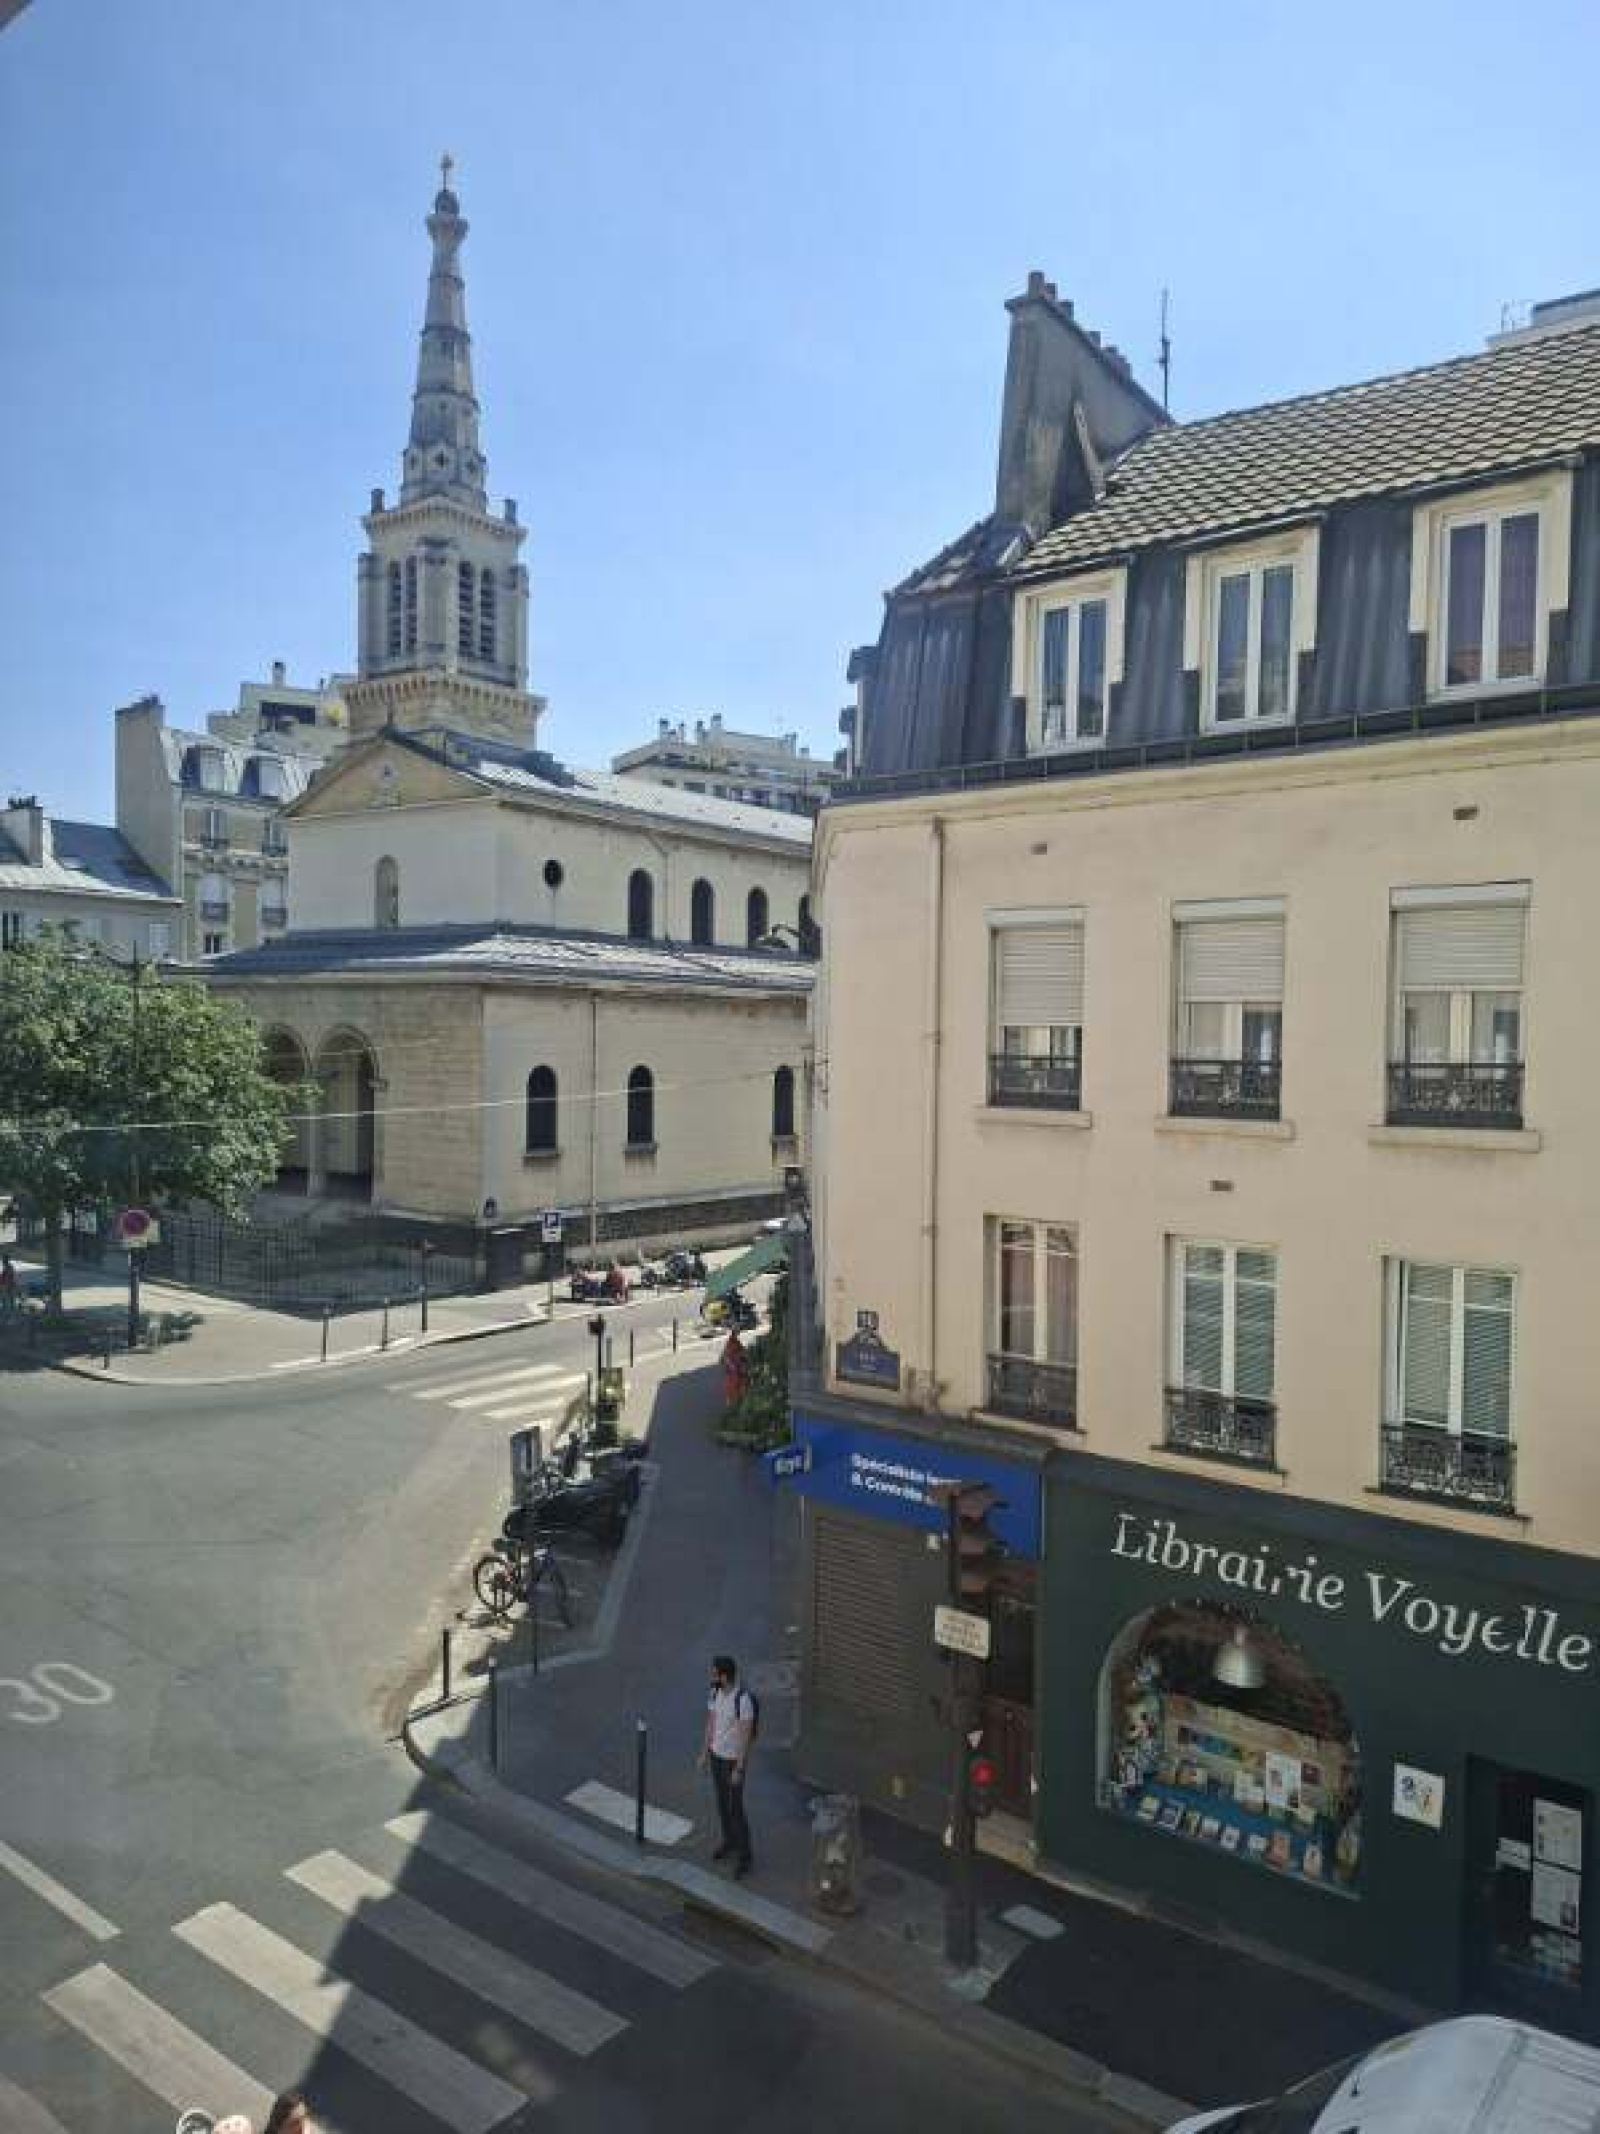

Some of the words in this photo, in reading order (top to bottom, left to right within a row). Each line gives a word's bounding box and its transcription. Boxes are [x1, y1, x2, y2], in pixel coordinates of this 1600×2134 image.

[1111, 1513, 1345, 1609] Librairie
[1365, 1572, 1592, 1671] Voyelle
[0, 1663, 113, 1723] 30
